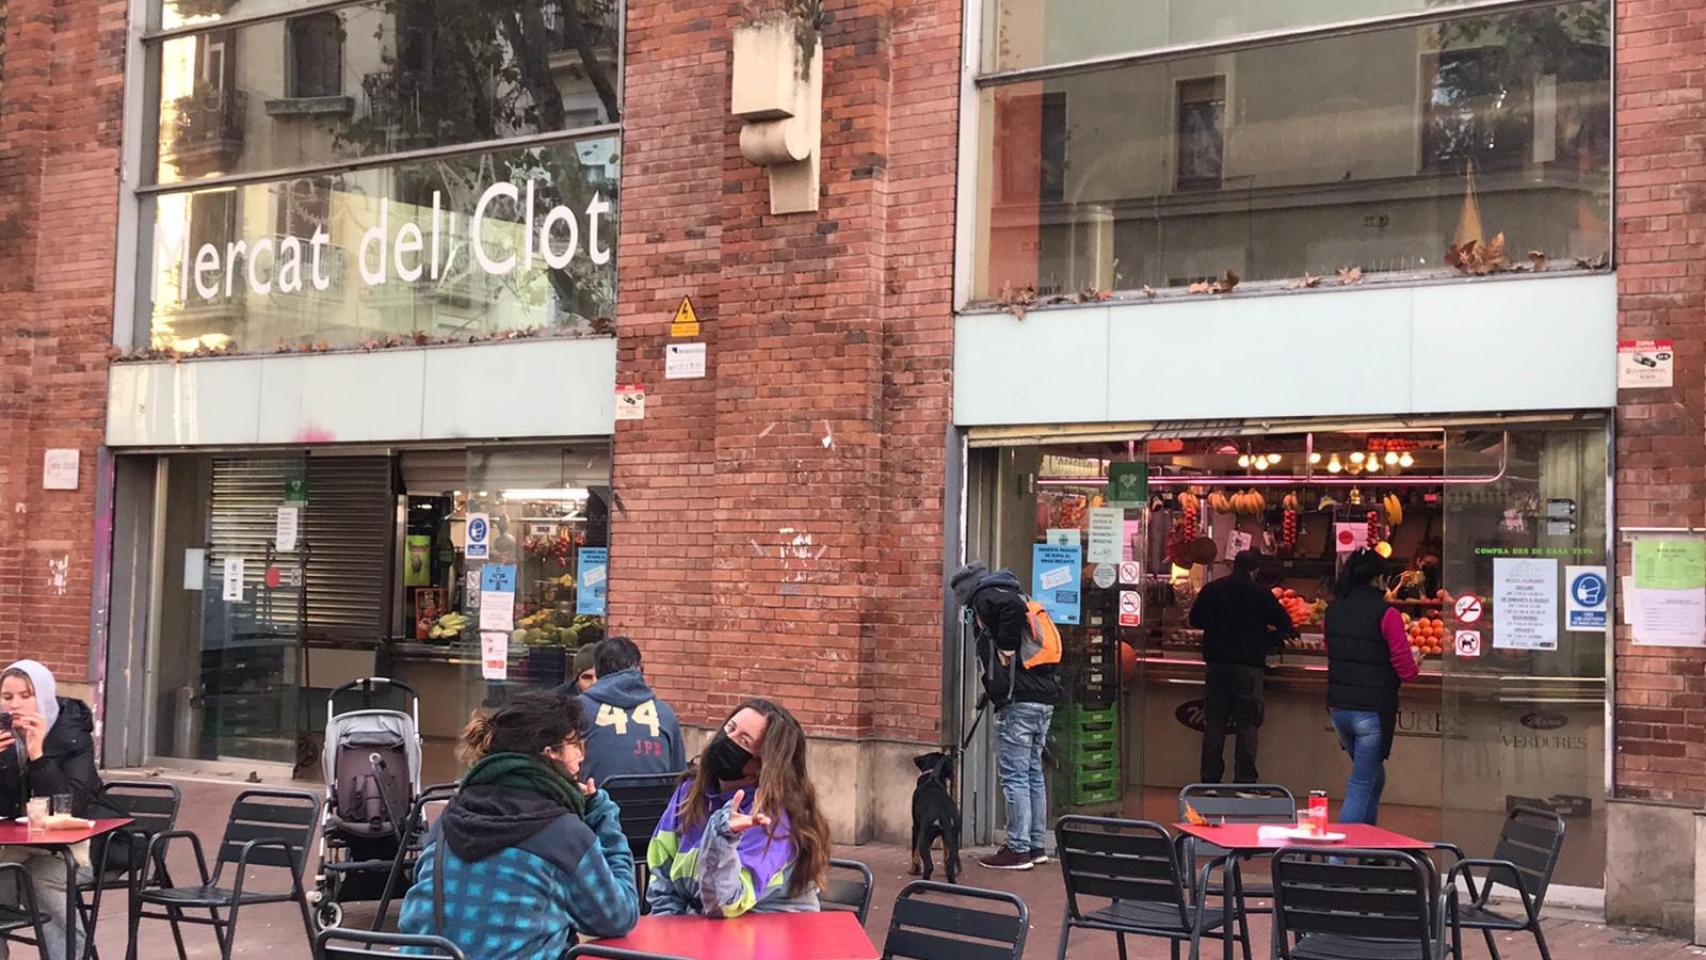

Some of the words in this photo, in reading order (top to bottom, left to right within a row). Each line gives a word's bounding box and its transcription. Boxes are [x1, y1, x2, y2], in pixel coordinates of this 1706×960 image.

[151, 217, 330, 301] Mercat
[358, 190, 440, 286] del
[471, 179, 610, 275] Clot
[1474, 547, 1510, 555] COMPRA
[595, 699, 660, 737] 44
[1501, 735, 1588, 750] VERDURES
